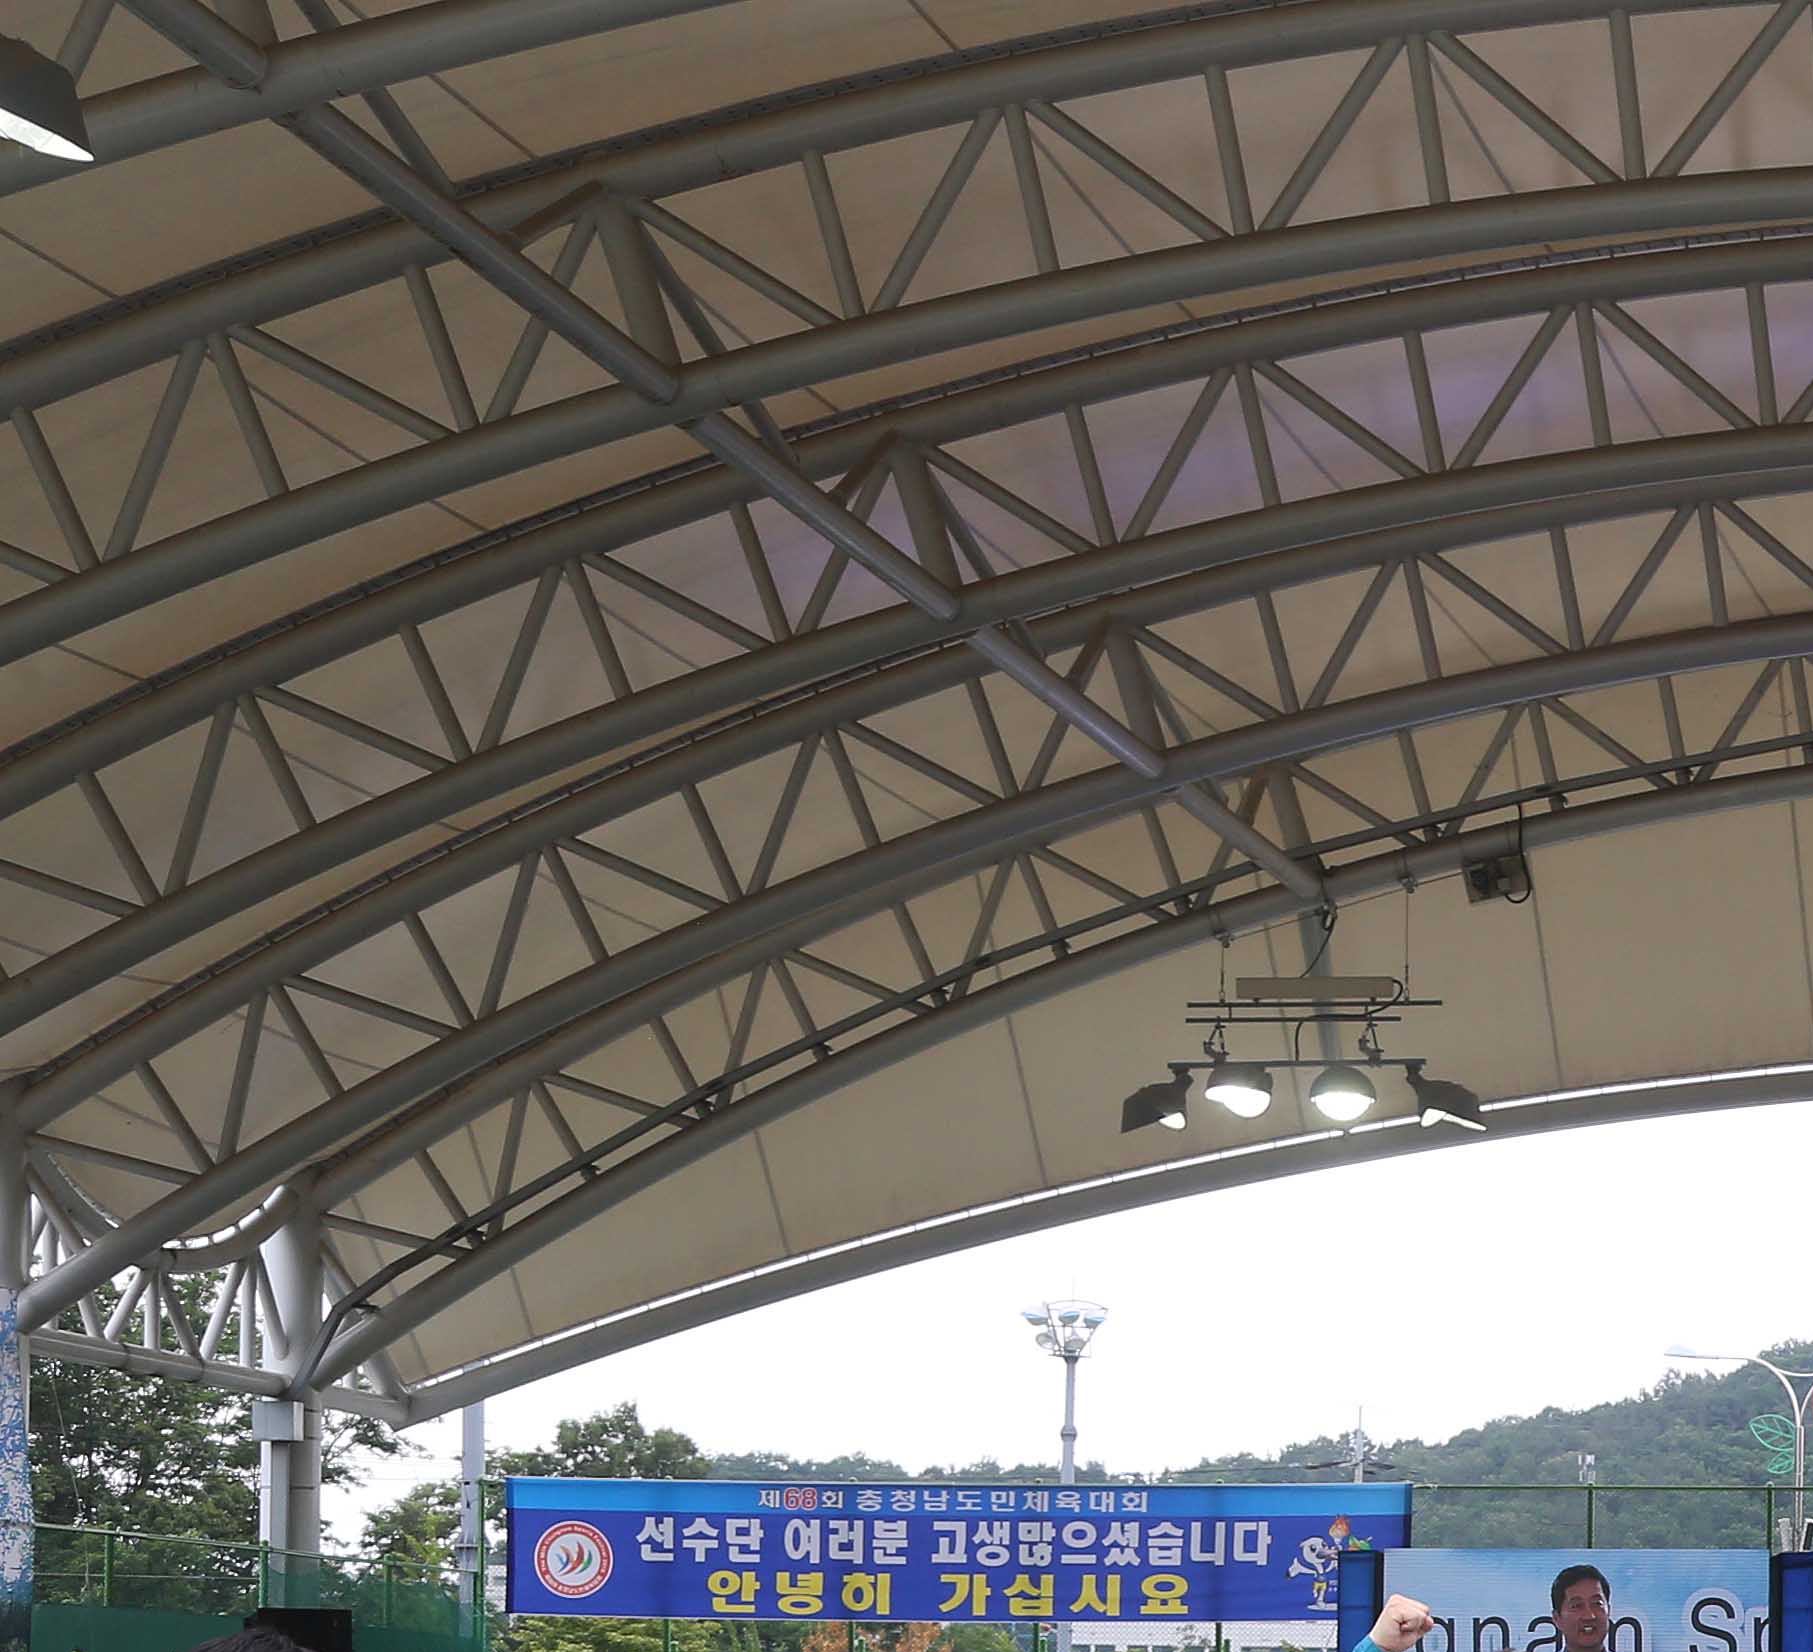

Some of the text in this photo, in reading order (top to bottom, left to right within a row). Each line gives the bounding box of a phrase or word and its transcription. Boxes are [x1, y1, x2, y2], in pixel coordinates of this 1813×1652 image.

[757, 1488, 1149, 1512] 제68회 충청남도민체육대회
[636, 1516, 764, 1563] 선수단
[783, 1518, 909, 1564] 여러분
[930, 1518, 1272, 1567] 고생많으셨습니다
[706, 1571, 1190, 1616] 안녕히 가십시요
